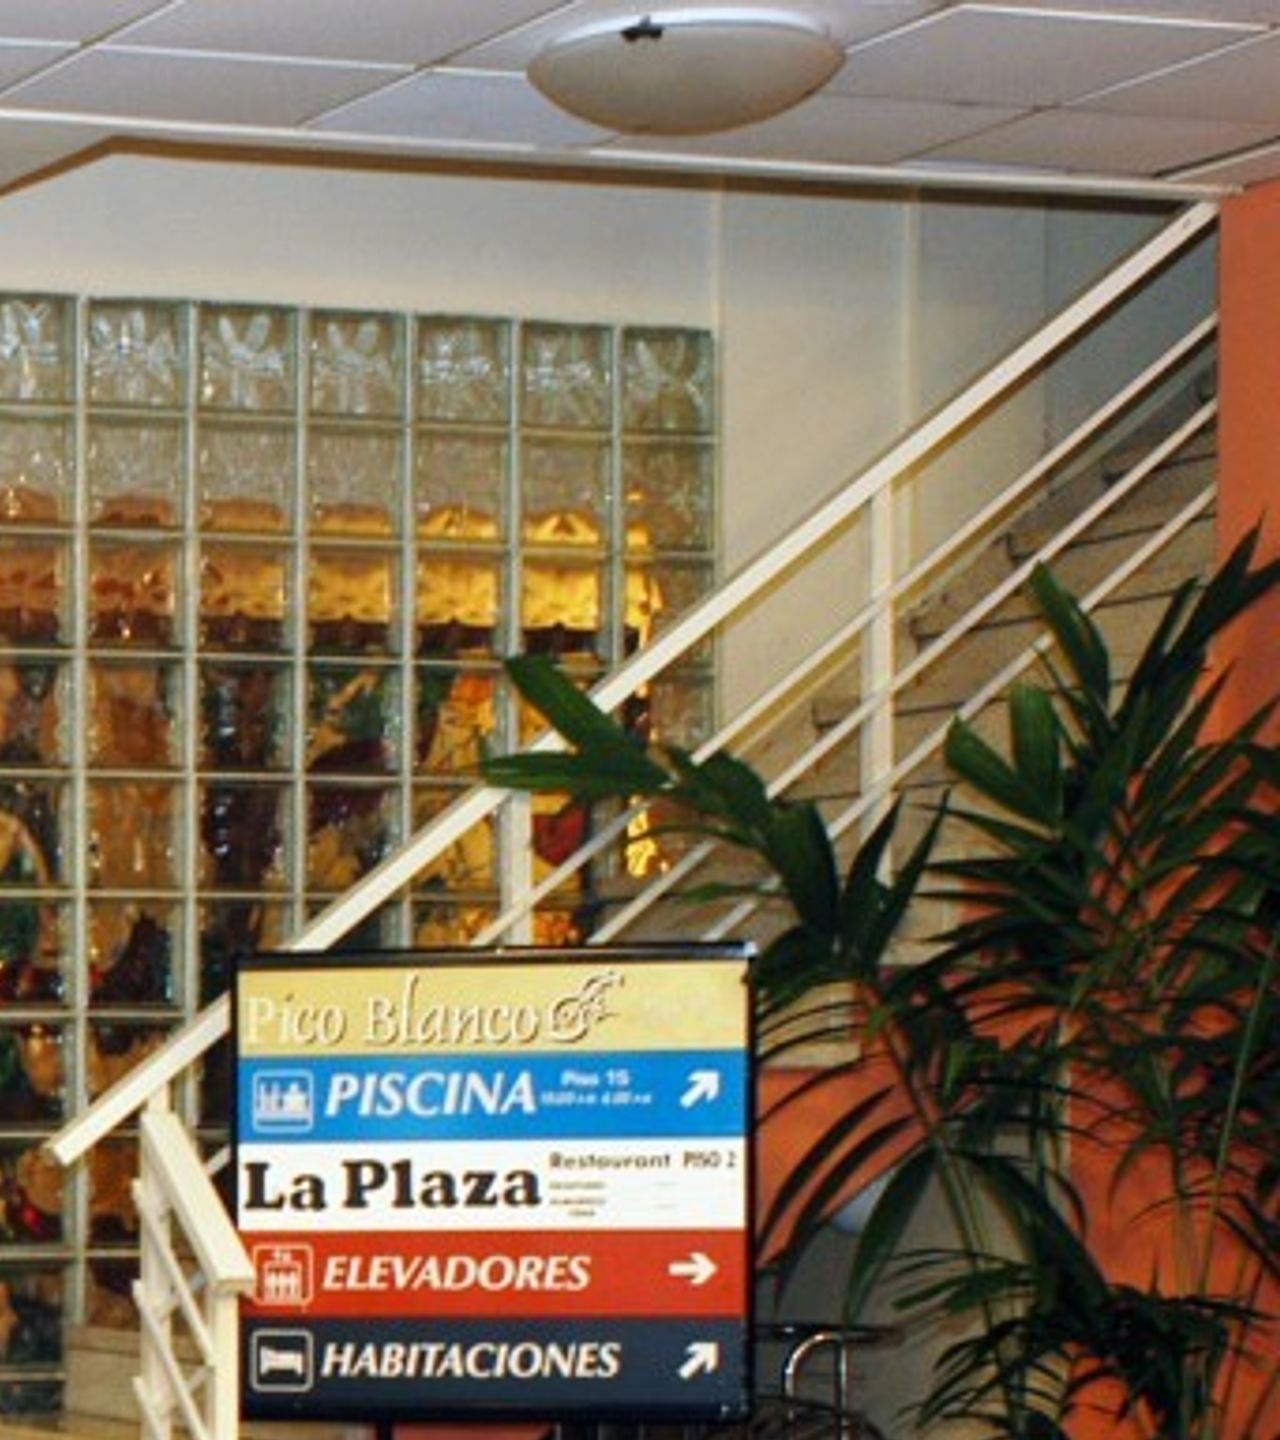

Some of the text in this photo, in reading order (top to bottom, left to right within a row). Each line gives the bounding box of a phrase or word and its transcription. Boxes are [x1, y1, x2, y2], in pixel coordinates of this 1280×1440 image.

[244, 973, 540, 1046] Pico Blanco
[324, 1072, 538, 1116] PISCINA
[549, 1151, 671, 1168] Restaurant
[243, 1159, 542, 1212] La Plaza
[322, 1254, 592, 1291] ELEVADORES
[321, 1342, 622, 1379] HABITACIONES
